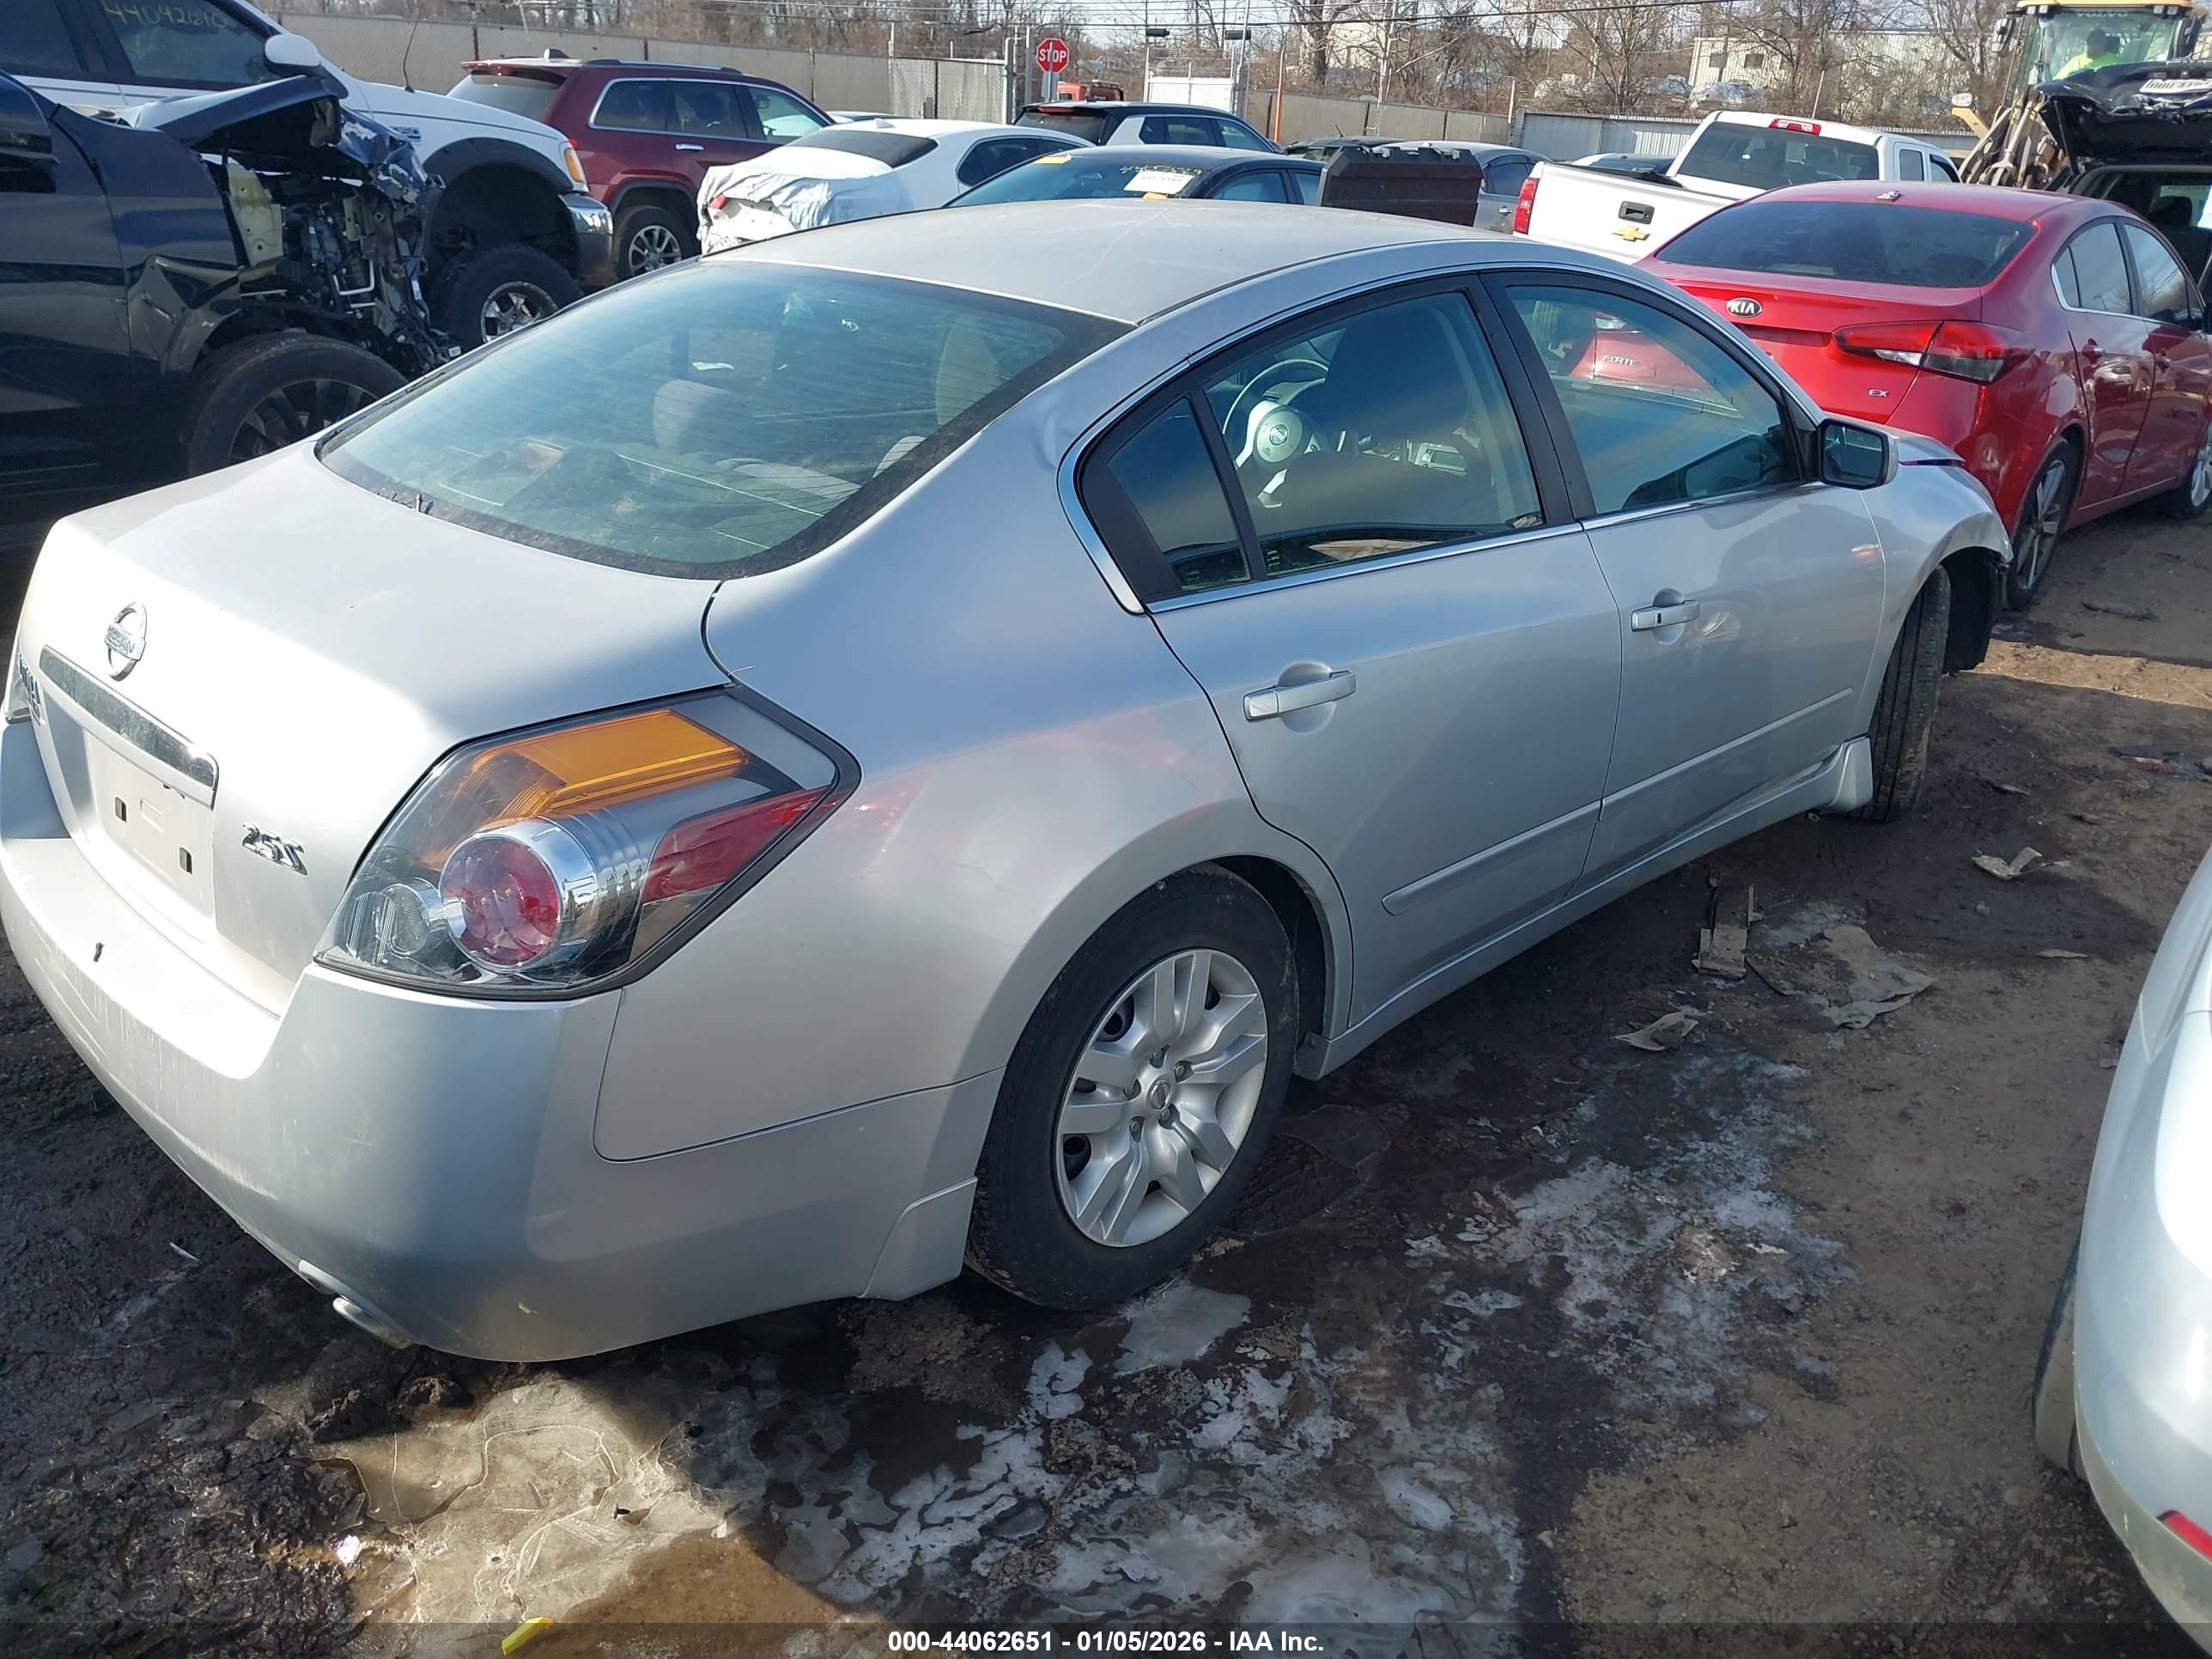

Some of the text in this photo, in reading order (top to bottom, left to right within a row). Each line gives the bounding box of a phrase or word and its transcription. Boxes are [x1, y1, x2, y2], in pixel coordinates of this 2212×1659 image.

[1038, 48, 1067, 64] STOP
[1729, 301, 1755, 314] KIA
[1869, 388, 1888, 398] EX
